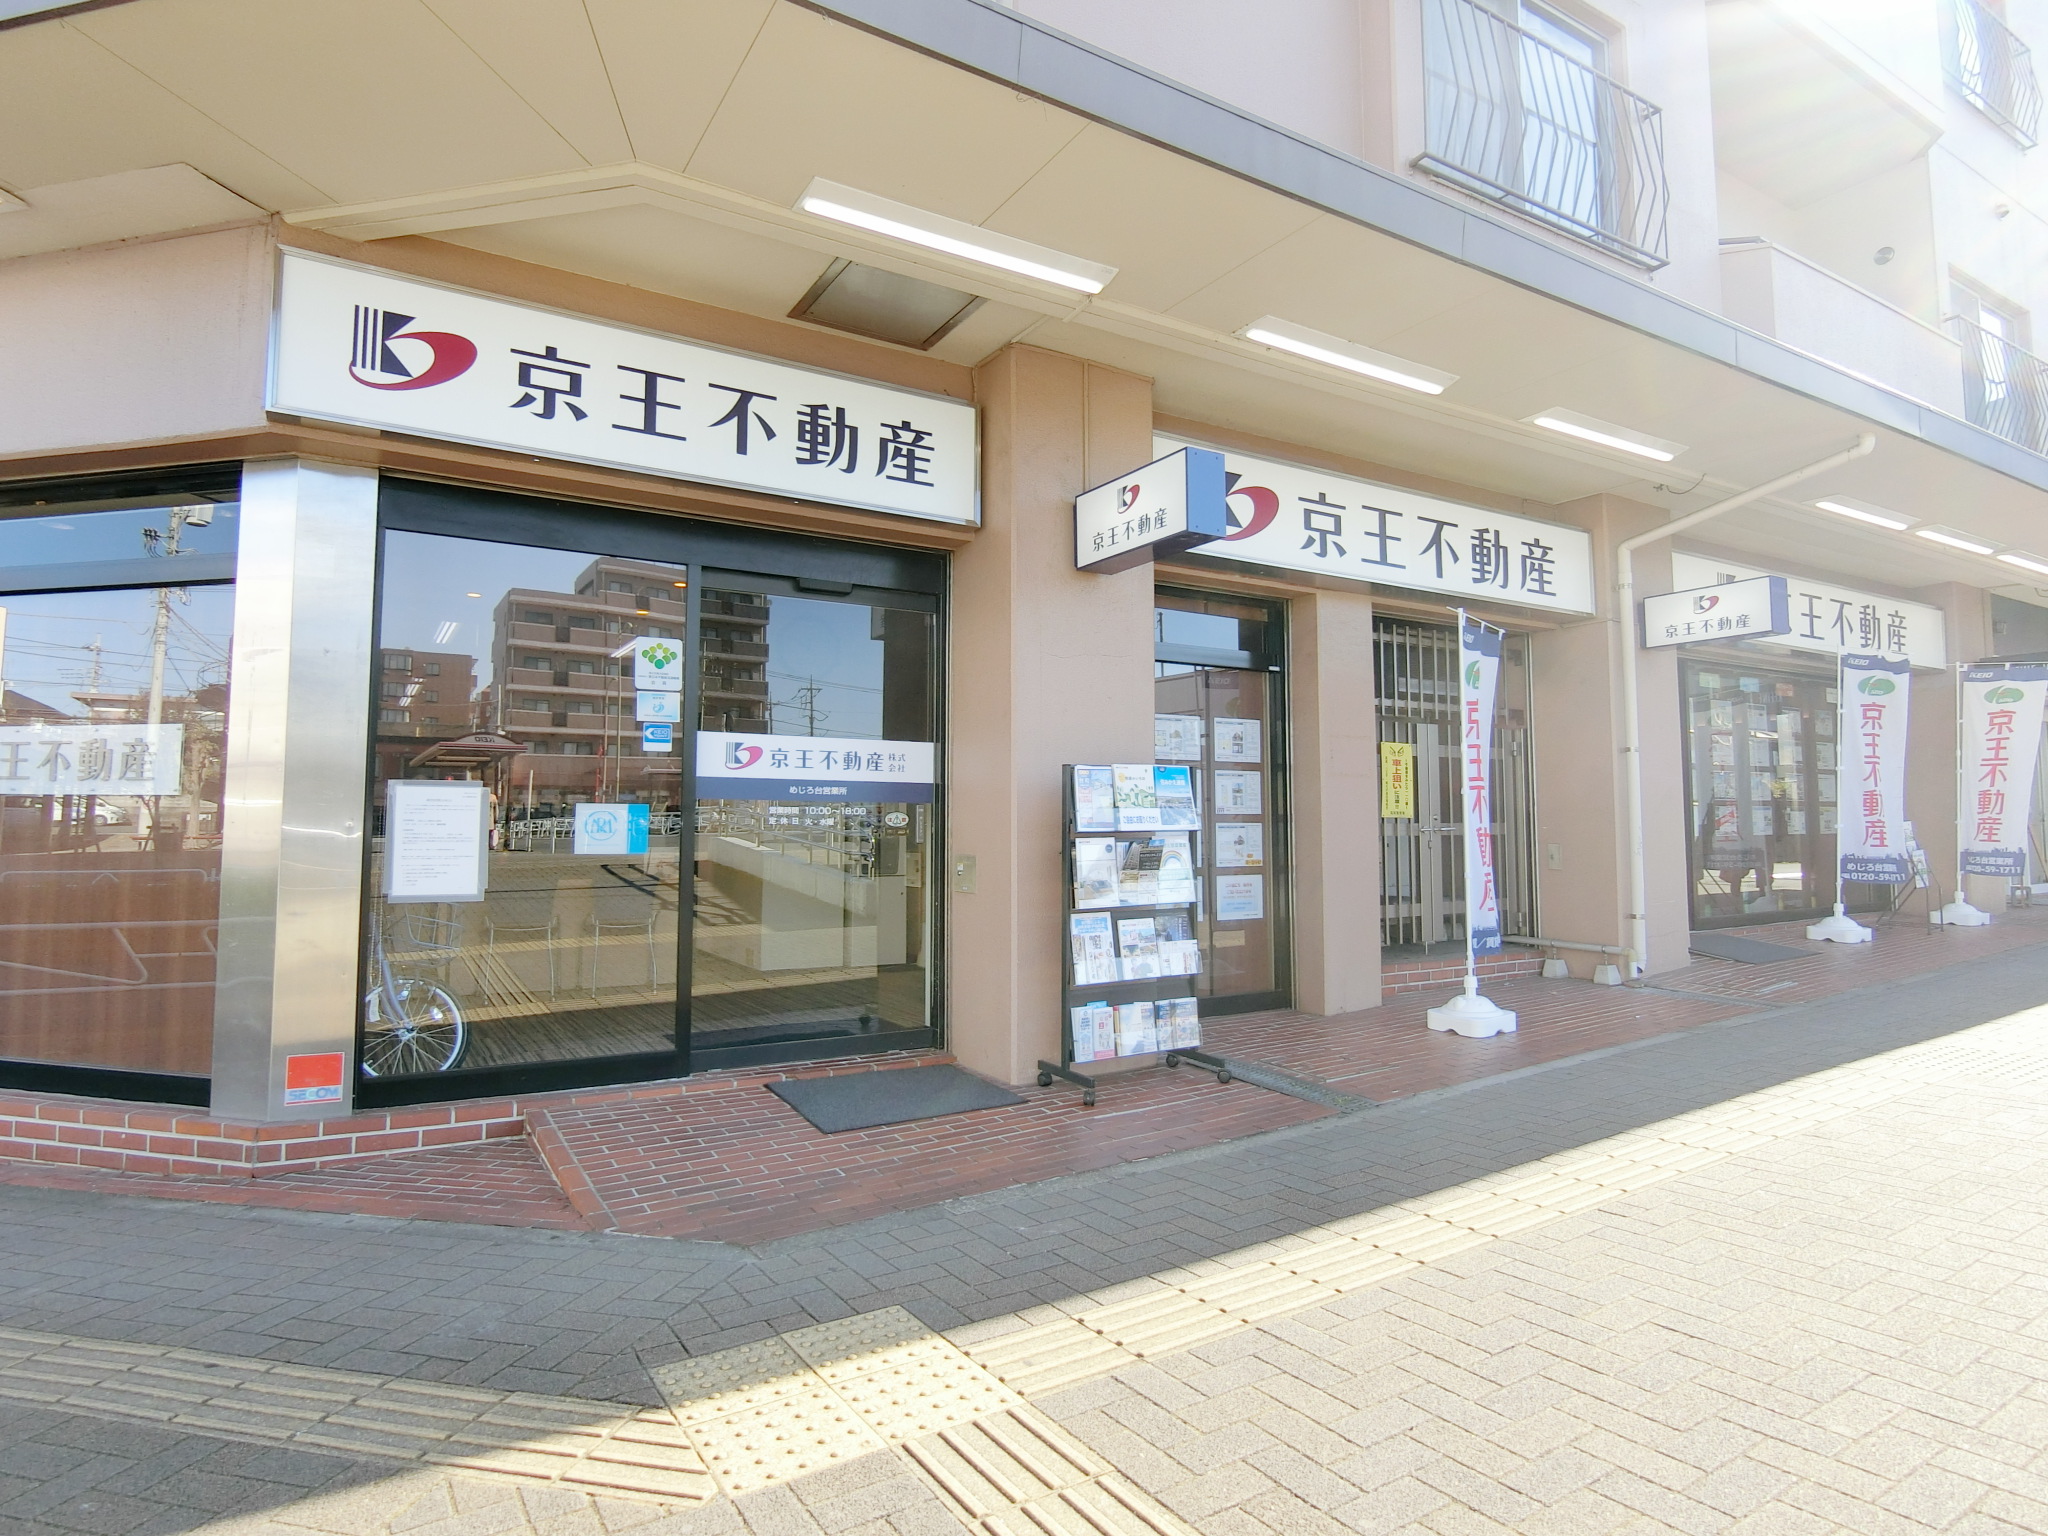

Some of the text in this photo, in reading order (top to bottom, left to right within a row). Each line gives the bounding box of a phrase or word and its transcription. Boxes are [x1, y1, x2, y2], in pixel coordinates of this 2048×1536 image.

[509, 345, 936, 489] 京王不動産
[1091, 507, 1168, 552] 京王不動産
[1298, 492, 1558, 598] 京王不動産
[1664, 613, 1752, 639] 京王不動産
[1787, 592, 1909, 656] 王不動産
[1968, 671, 1994, 679] KEIO
[0, 737, 157, 782] 王不動産
[770, 747, 885, 772] 京王不動産
[1859, 700, 1889, 849] 京王不動産
[1973, 708, 2017, 843] 京王不動産
[768, 806, 800, 815] 営業時間
[789, 785, 848, 796] めじろ台営業所
[287, 1087, 340, 1102] SECOM
